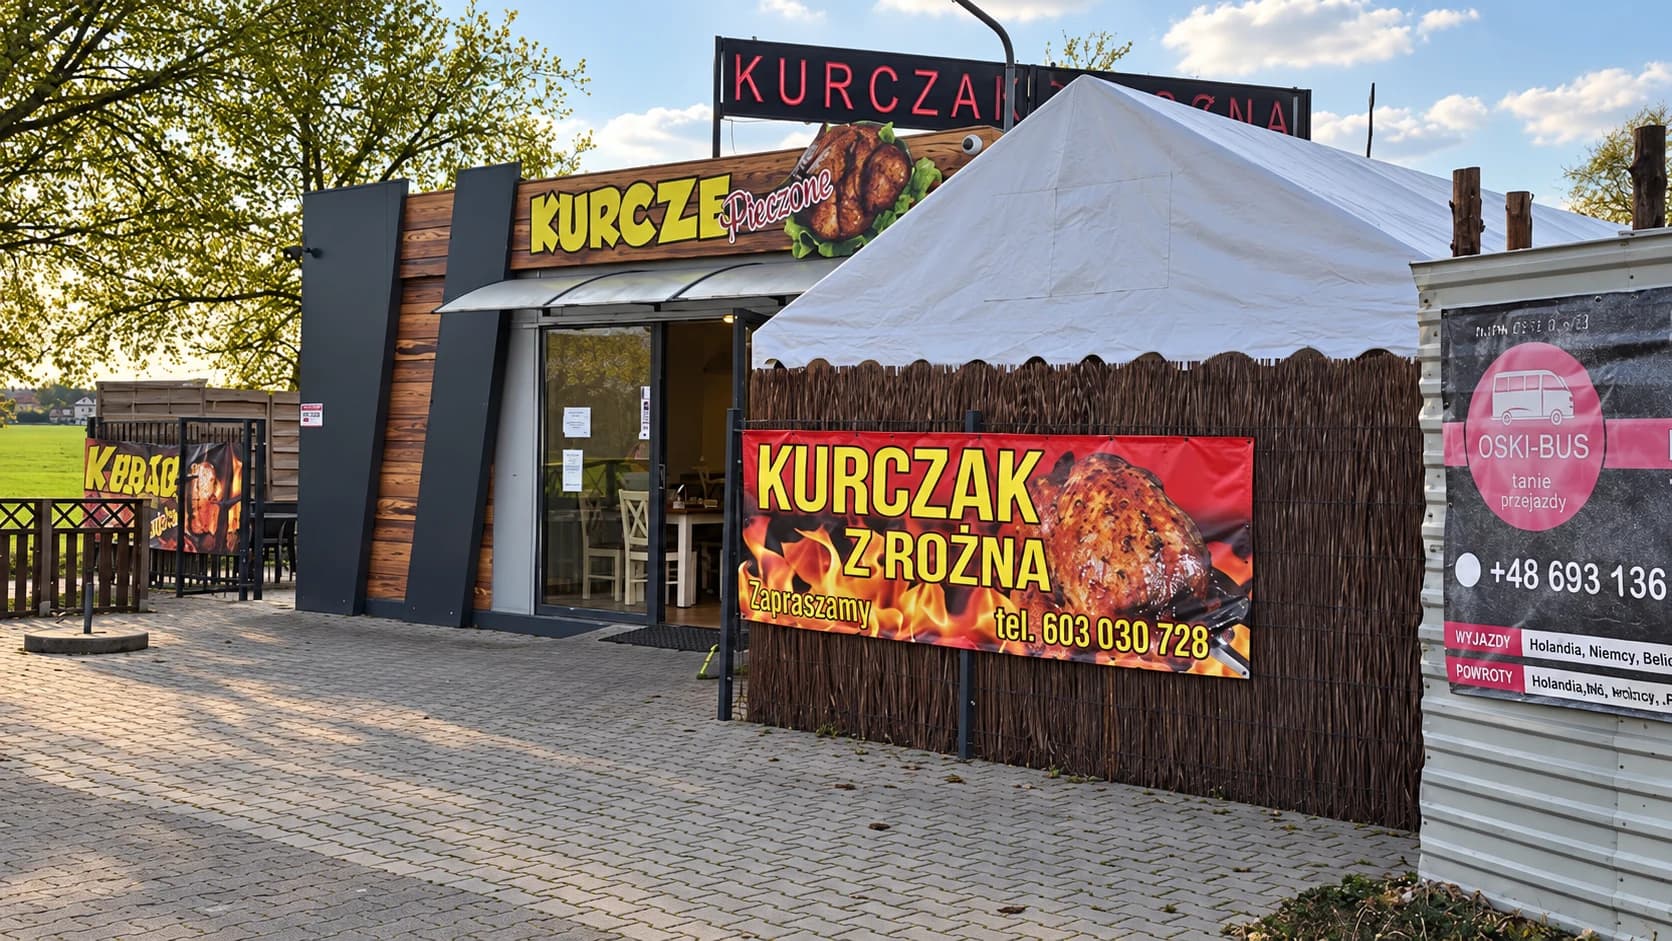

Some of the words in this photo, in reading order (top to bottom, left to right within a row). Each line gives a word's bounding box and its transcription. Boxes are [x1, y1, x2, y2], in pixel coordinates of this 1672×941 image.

[734, 53, 1020, 121] KURCZAK
[529, 174, 733, 255] KURCZE
[718, 168, 834, 244] Pieczone
[1478, 433, 1590, 459] OSKI-BUS
[757, 443, 1044, 524] KURCZAK
[1501, 493, 1567, 513] przejazdy
[1512, 473, 1551, 489] tanie
[843, 527, 875, 578] Z
[884, 525, 1052, 592] ROŻNA
[1490, 557, 1540, 590] +48
[1548, 560, 1601, 595] 693
[1610, 564, 1667, 601] 136
[749, 579, 871, 629] Zapraszamy
[994, 606, 1035, 643] tel.
[1042, 613, 1091, 647] 603
[1097, 620, 1150, 655] 030
[1157, 624, 1210, 660] 728
[1455, 630, 1511, 649] WYJAZDY
[1529, 638, 1586, 659] Holandia,
[1589, 644, 1640, 666] Niemcy,
[1456, 664, 1513, 684] POWROTY
